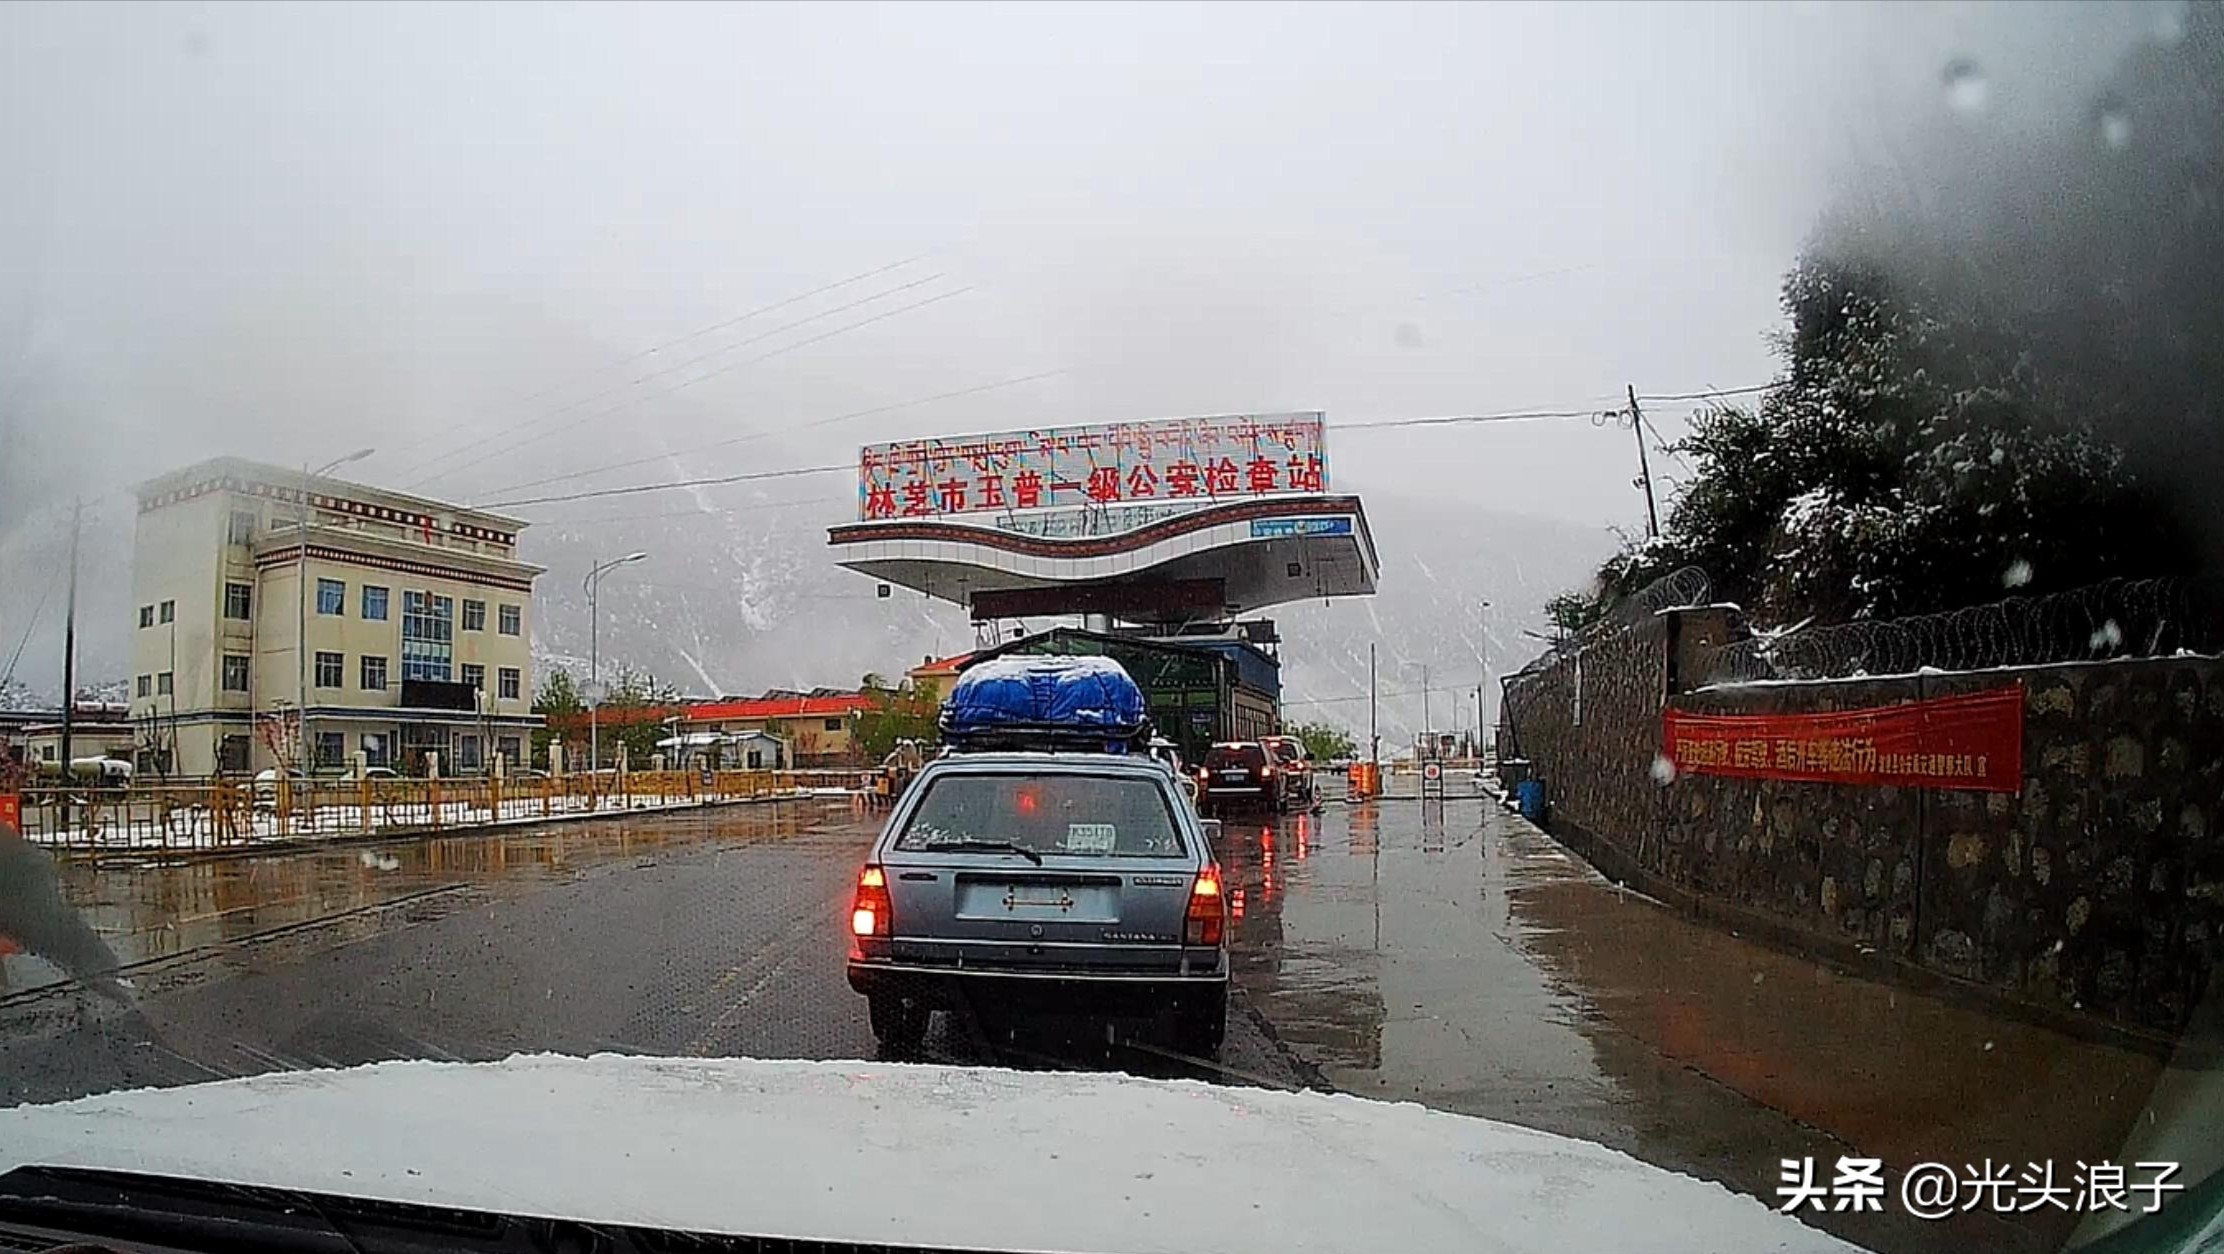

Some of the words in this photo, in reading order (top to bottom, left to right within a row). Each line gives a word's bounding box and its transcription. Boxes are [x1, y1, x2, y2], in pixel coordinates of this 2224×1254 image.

[867, 453, 1323, 518] 林芝市玉普一级公安检查站
